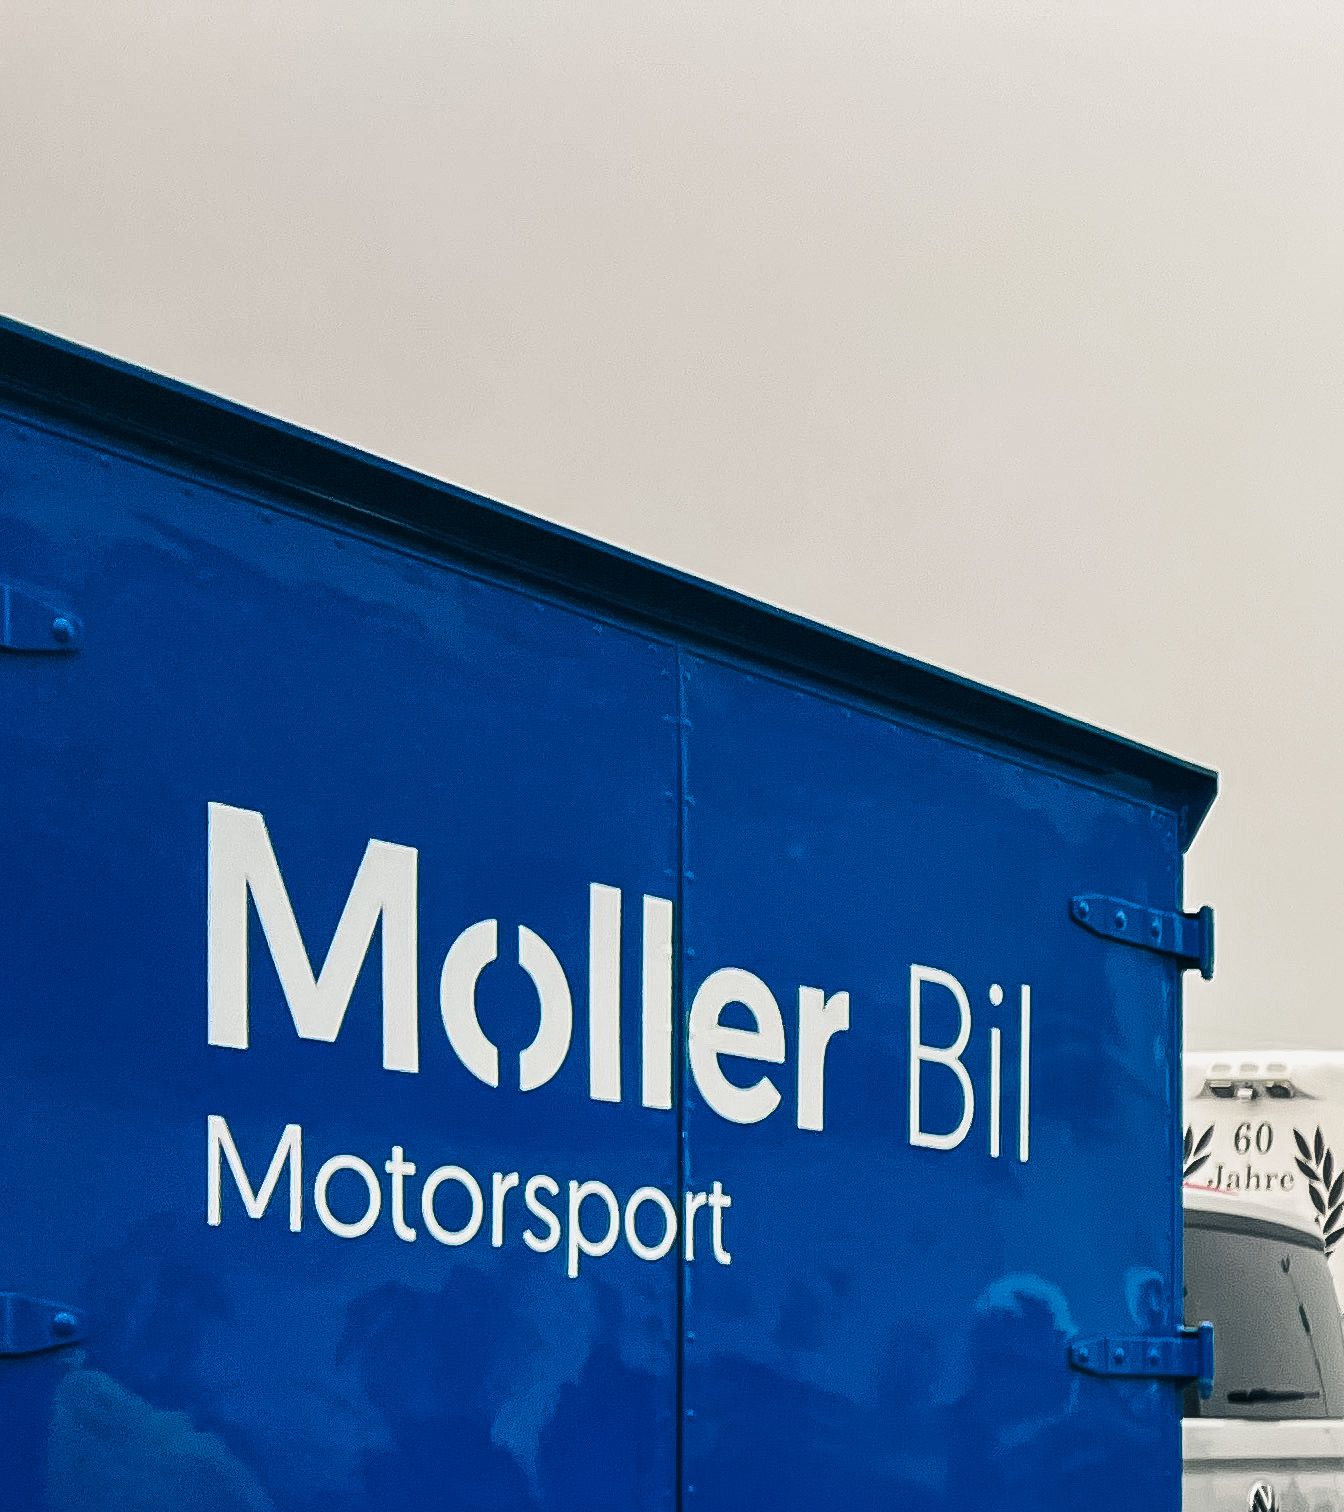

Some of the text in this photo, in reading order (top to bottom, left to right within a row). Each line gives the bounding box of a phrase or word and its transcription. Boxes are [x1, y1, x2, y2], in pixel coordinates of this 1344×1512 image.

[909, 963, 1031, 1163] Bil
[1208, 1163, 1295, 1191] Jahre
[1234, 1121, 1274, 1155] 60
[207, 1114, 731, 1278] Motorsport
